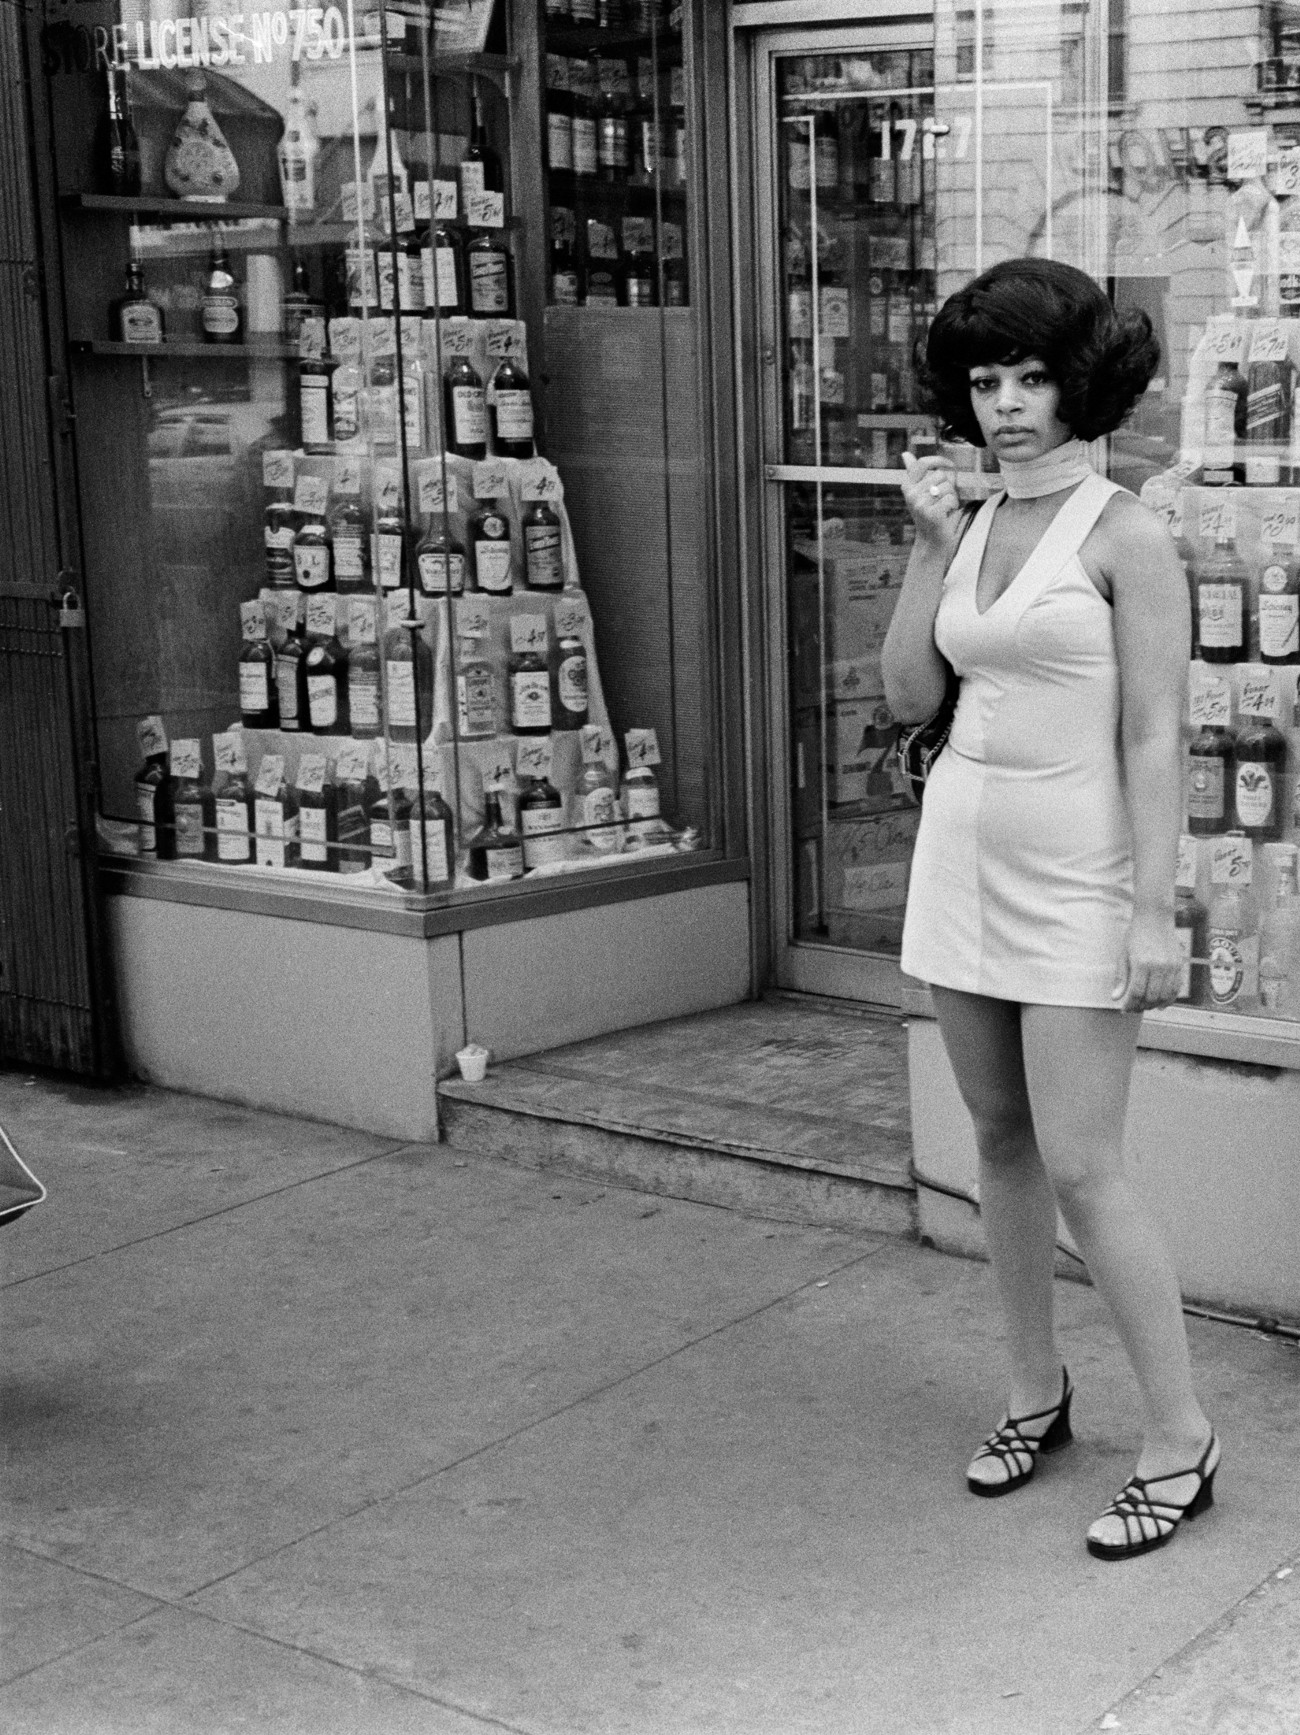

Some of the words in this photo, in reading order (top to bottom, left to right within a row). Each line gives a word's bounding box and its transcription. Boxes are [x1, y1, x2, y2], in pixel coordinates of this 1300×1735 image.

[41, 20, 130, 75] STORE
[136, 14, 245, 69] LICENSE
[288, 6, 343, 60] 750
